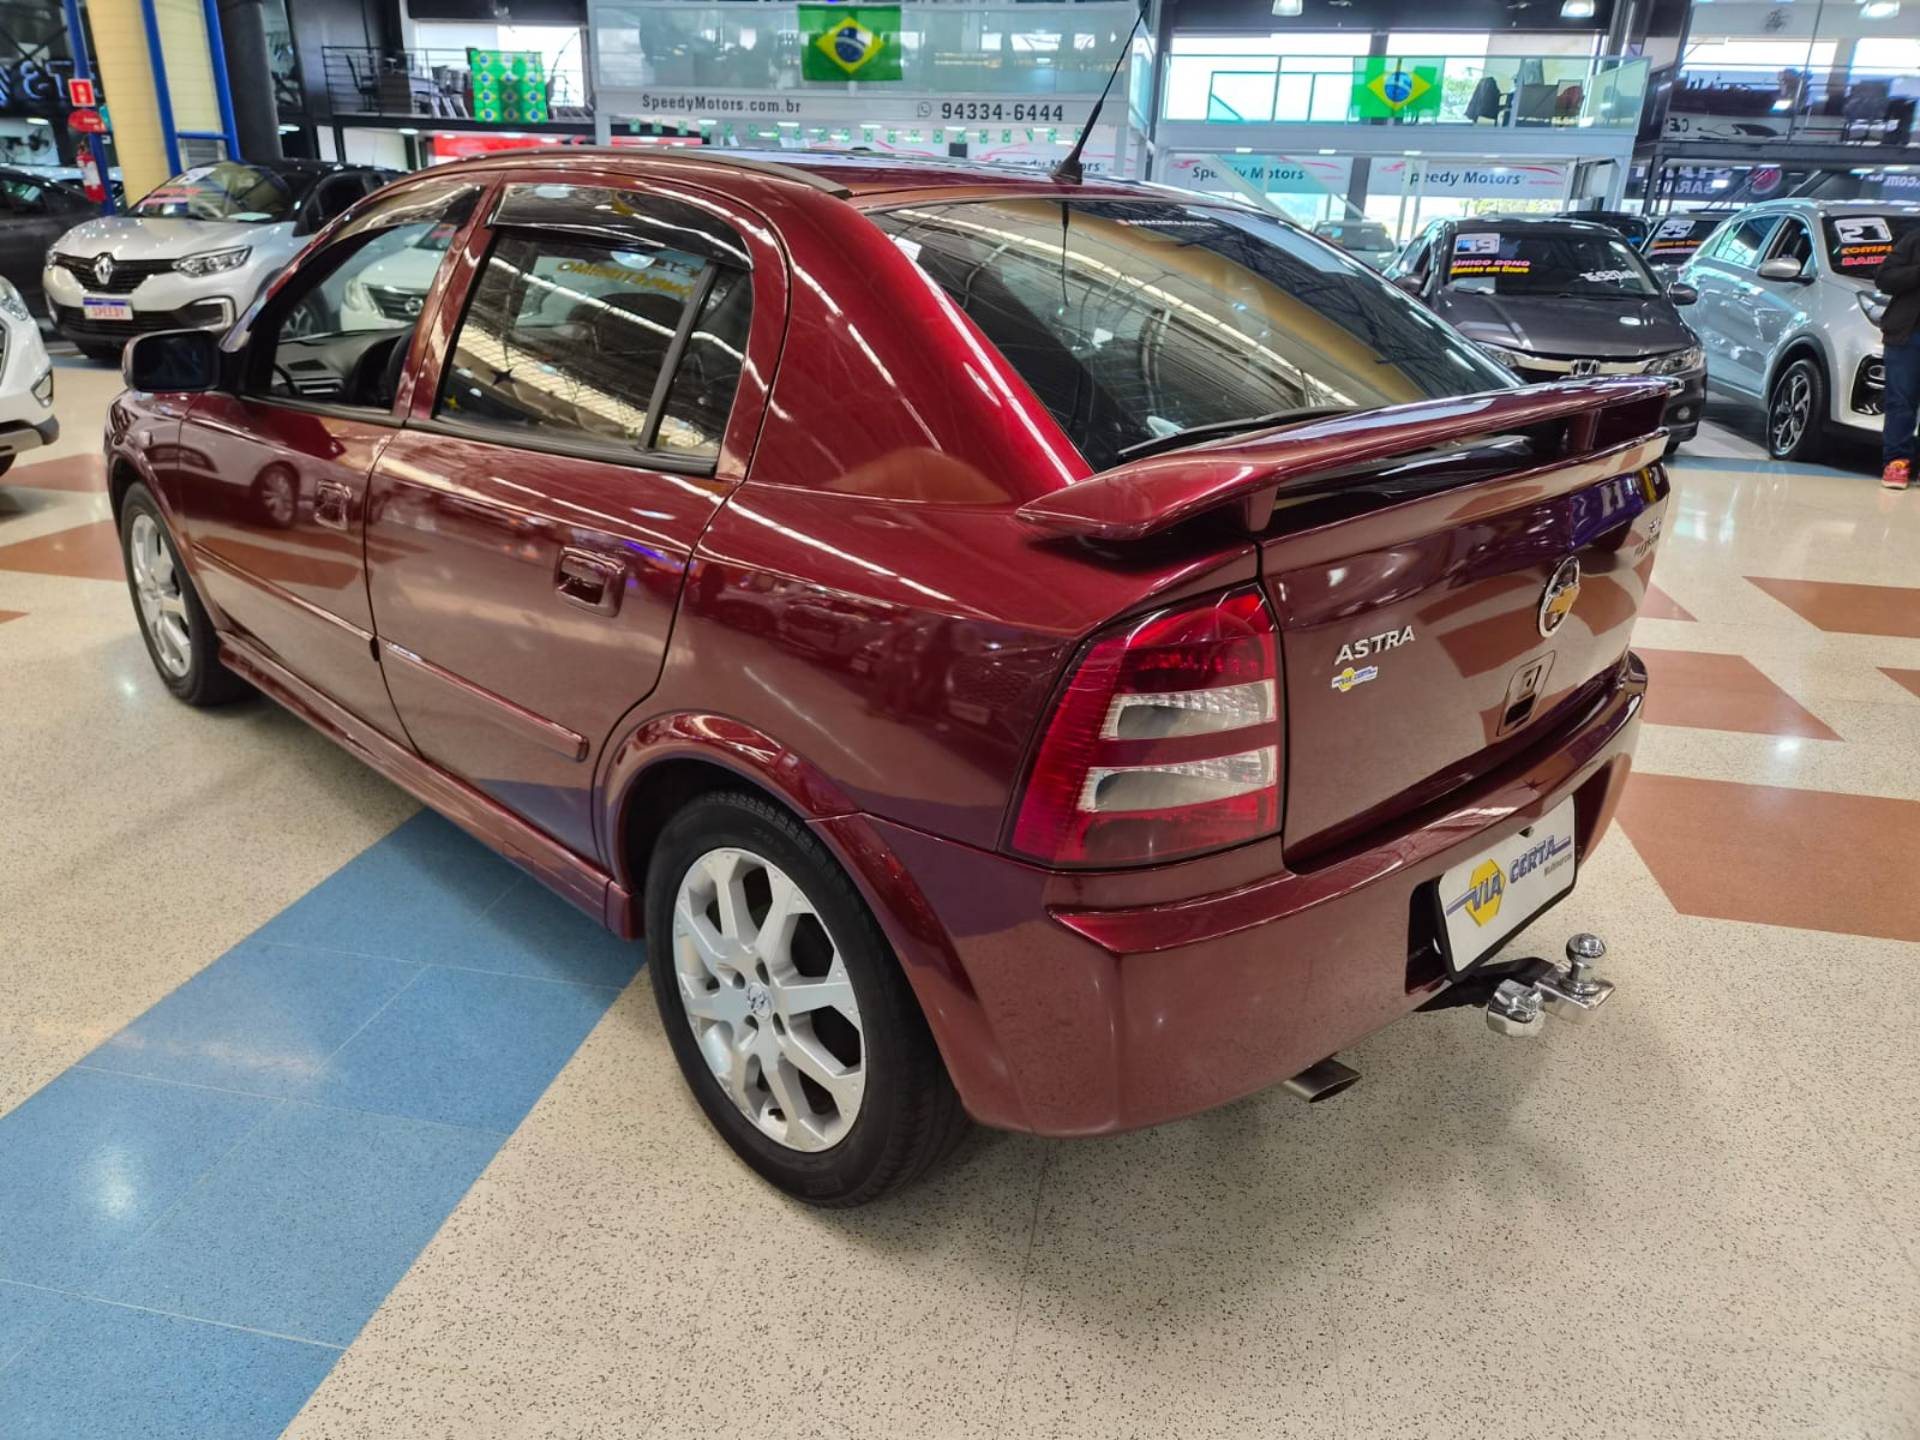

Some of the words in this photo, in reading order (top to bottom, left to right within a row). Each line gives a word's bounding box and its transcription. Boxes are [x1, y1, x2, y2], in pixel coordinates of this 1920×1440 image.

[642, 93, 802, 113] SpeedyMotors.com.br
[941, 102, 1063, 121] 94334-6444
[1401, 170, 1460, 187] pedy
[1463, 171, 1521, 185] Motors
[1334, 624, 1416, 666] ASTRA
[1470, 869, 1503, 912] VIA
[1509, 834, 1557, 884] CERTA
